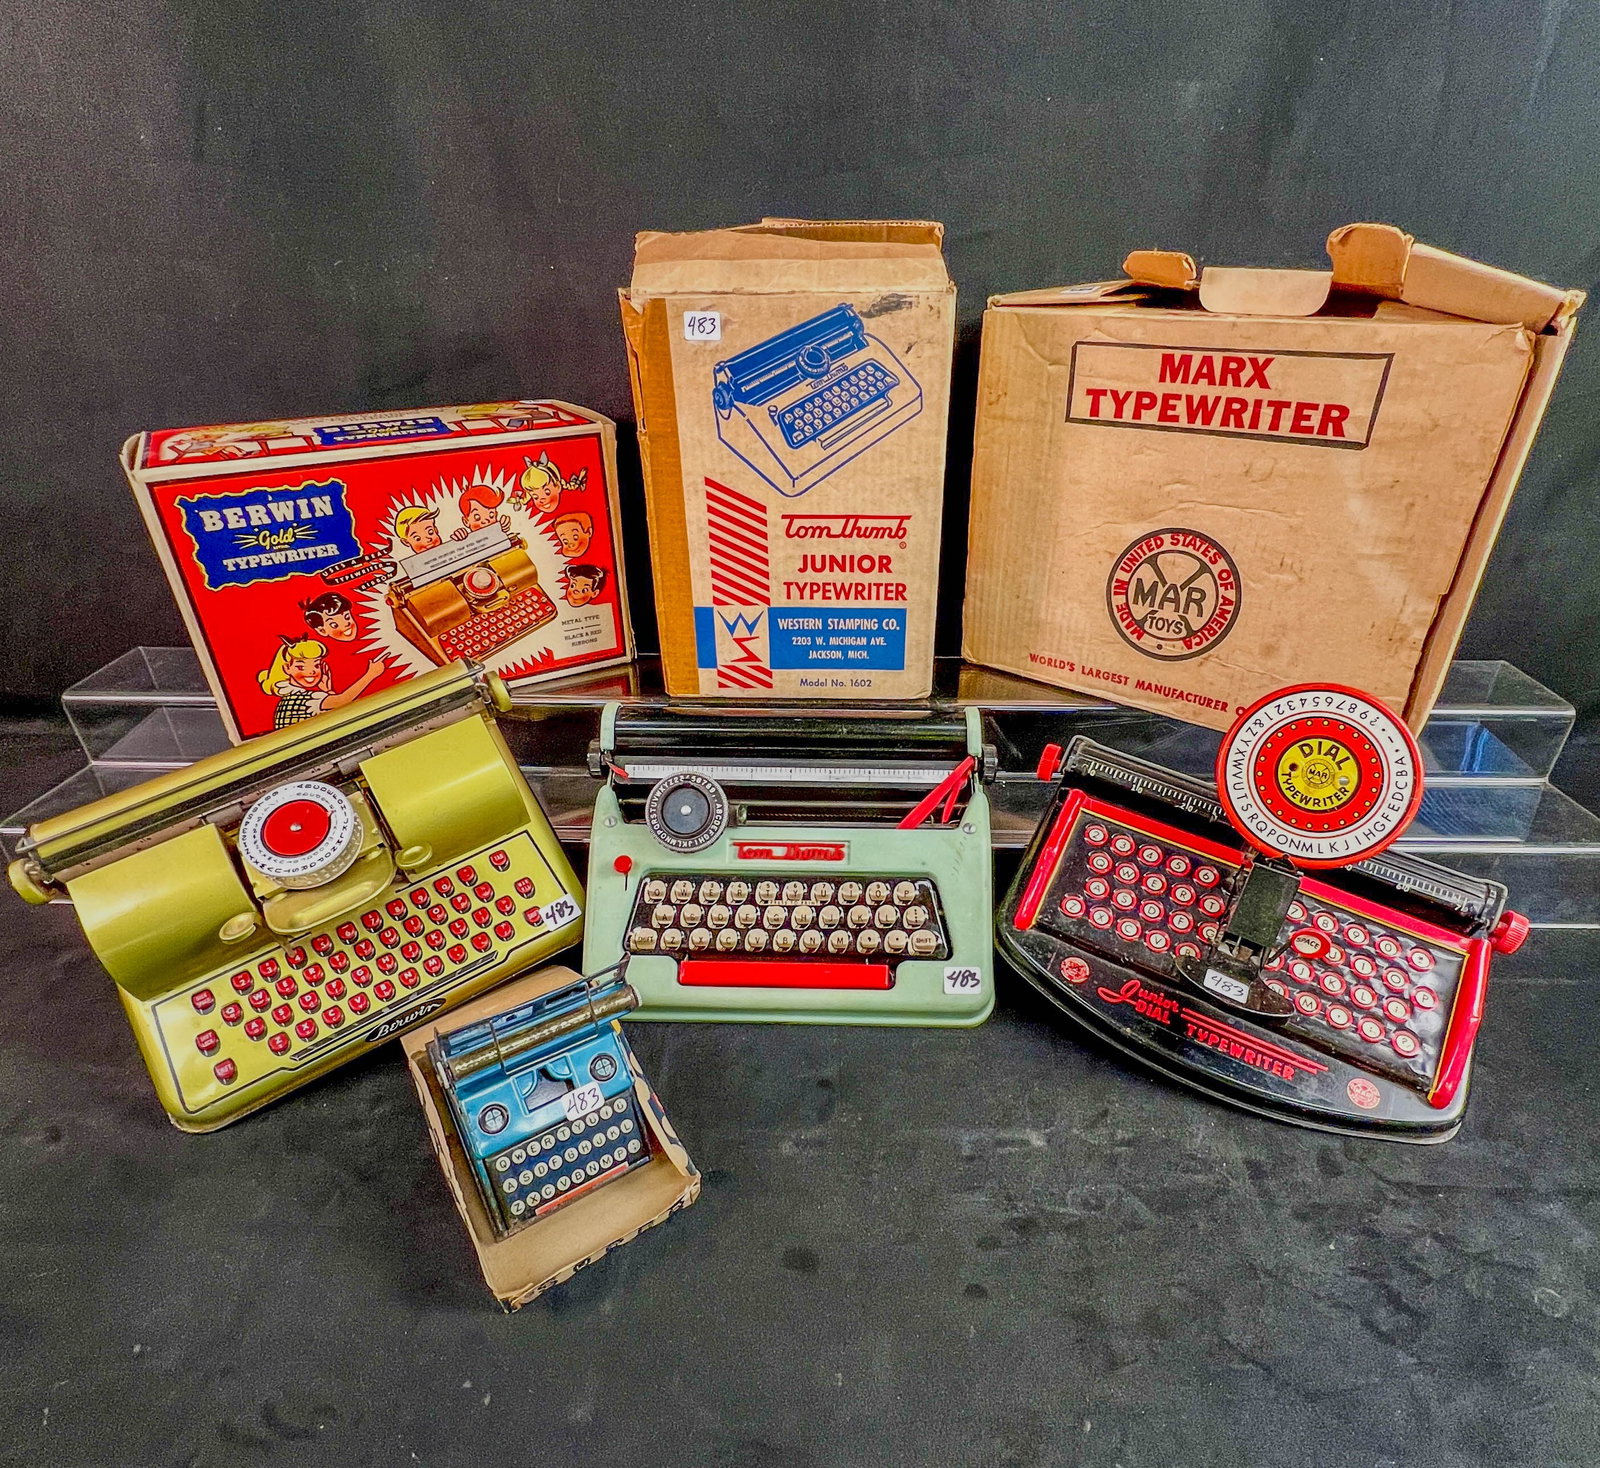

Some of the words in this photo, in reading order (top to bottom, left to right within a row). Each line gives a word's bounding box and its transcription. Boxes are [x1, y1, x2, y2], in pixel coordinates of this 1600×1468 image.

[688, 317, 716, 336] 483
[1158, 353, 1276, 390] MARX
[1086, 388, 1350, 437] TYPEWRITER
[334, 427, 438, 442] TYPEWRITER
[200, 496, 334, 532] BERWIN
[781, 514, 839, 539] Tom
[838, 514, 912, 539] Thumb
[259, 528, 295, 550] Gold
[1170, 532, 1224, 565] STATES
[222, 543, 340, 572] TYPEWRITER
[322, 563, 346, 577] USES
[365, 550, 388, 560] REAL
[798, 554, 893, 573] JUNIOR
[1120, 535, 1165, 574] UNITED
[361, 573, 393, 590] RIBBON
[783, 582, 908, 600] TYPEWRITER
[1113, 578, 1128, 596] IN
[1217, 569, 1234, 591] OF
[1132, 578, 1206, 618] MAR
[778, 618, 822, 630] WESTERN
[828, 618, 878, 630] STAMPING
[882, 618, 900, 630] CO.
[1116, 602, 1145, 641] MADE
[1148, 615, 1183, 635] TOYS
[1182, 595, 1235, 650] AMERICA
[792, 637, 812, 645] 2203
[816, 637, 826, 646] W.
[829, 637, 867, 646] MICHIGAN
[870, 637, 887, 646] AVE.
[808, 650, 844, 660] JACKSON,
[848, 650, 869, 660] MICH.
[800, 678, 828, 687] Model
[1029, 653, 1076, 672] WORLD'S
[1081, 665, 1130, 686] LARGEST
[1135, 679, 1229, 713] MANUFACTURER
[1298, 741, 1350, 770] DIAL
[1309, 769, 1328, 779] MAR
[1281, 772, 1350, 807] TYPEWRITER
[786, 843, 845, 861] Thumb
[546, 900, 574, 924] 483
[1296, 937, 1320, 950] SPACE
[947, 969, 980, 988] 483
[1212, 976, 1244, 996] 483
[1097, 979, 1180, 1014] Junior
[369, 1003, 441, 1042] Berwin
[1135, 1000, 1171, 1025] DIAL
[1185, 1023, 1296, 1081] TYPEWRITER
[567, 1087, 600, 1114] 483
